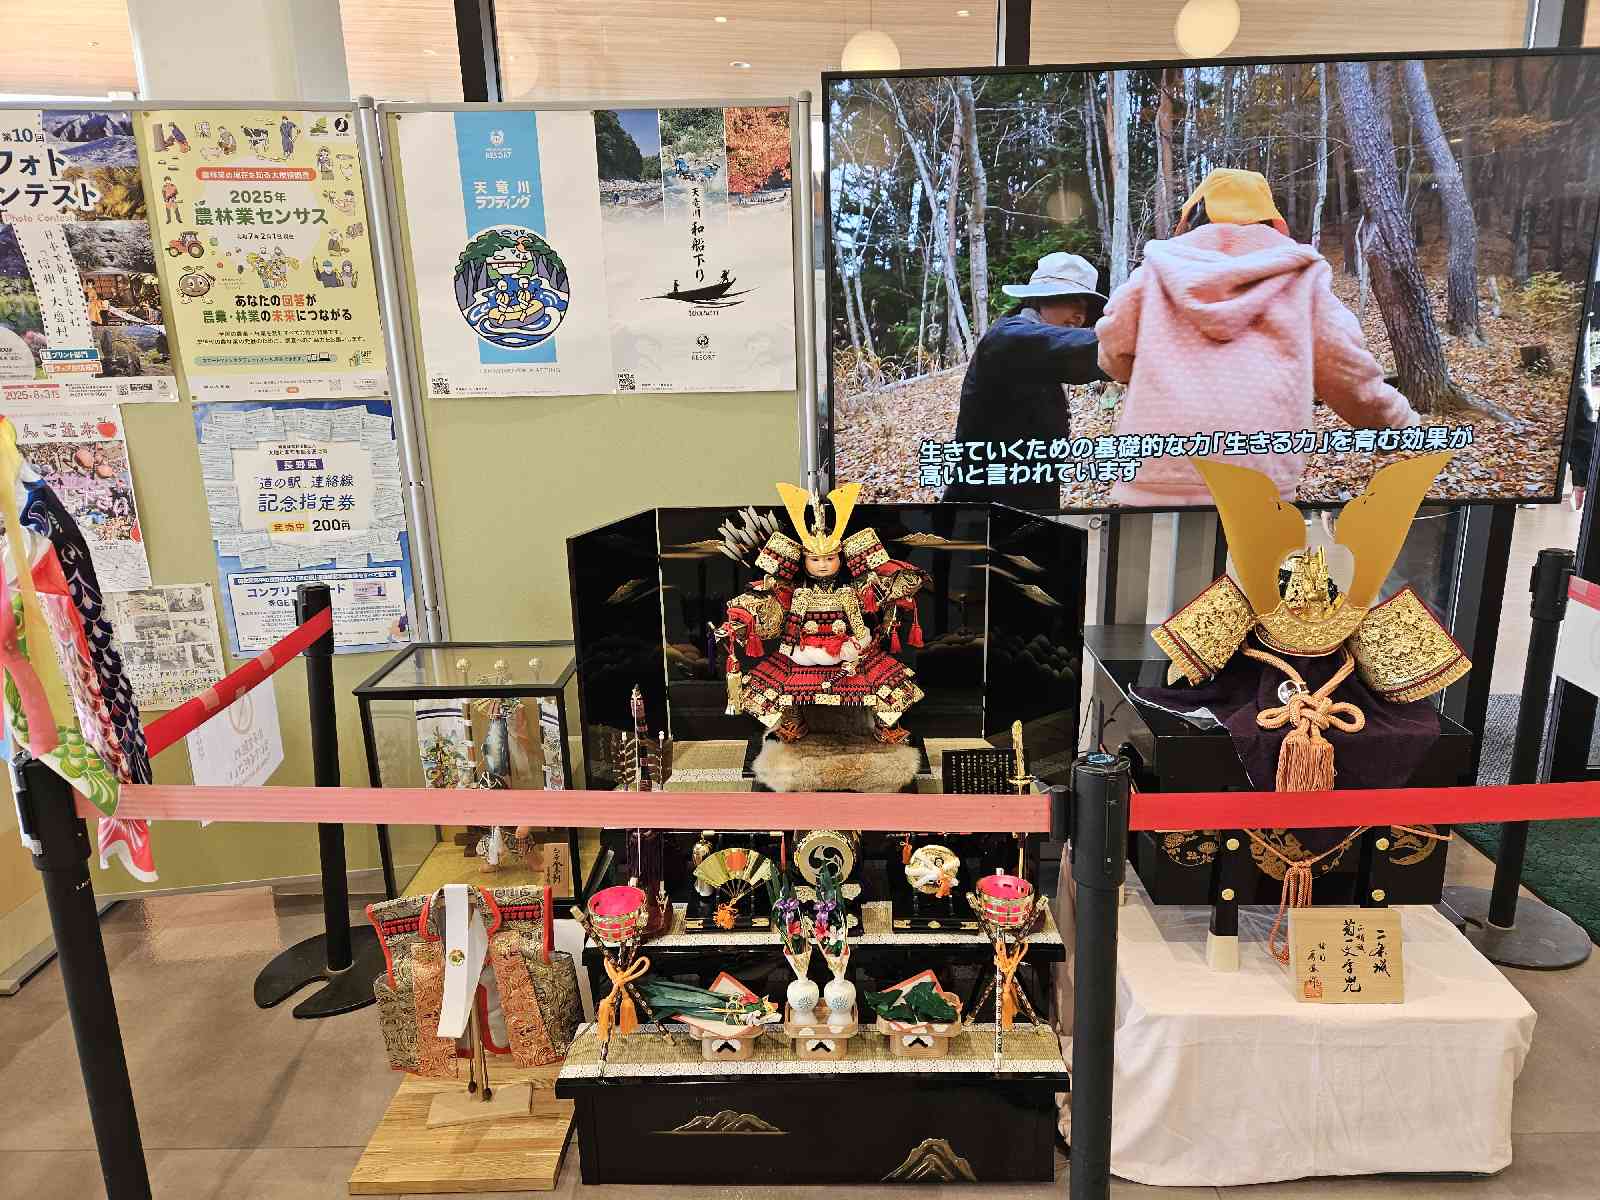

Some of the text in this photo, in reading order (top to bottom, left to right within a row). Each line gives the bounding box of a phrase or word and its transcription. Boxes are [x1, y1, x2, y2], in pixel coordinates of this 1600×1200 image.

[2, 128, 45, 143] 第10回
[473, 180, 531, 194] 天竜川
[230, 190, 287, 204] 2025年
[475, 194, 533, 209] ラフティング
[195, 207, 329, 225] 農林業センサス
[235, 294, 316, 307] あなたの回答が
[203, 309, 352, 324] 農業・林業の未来につながる
[918, 425, 1474, 463] 生きていくための基礎的な力「生きる力」を育む効果が
[284, 459, 318, 470] 長野県
[918, 458, 1142, 488] 高いと言われています
[258, 493, 356, 513] 記念指定券
[312, 518, 351, 532] 200円
